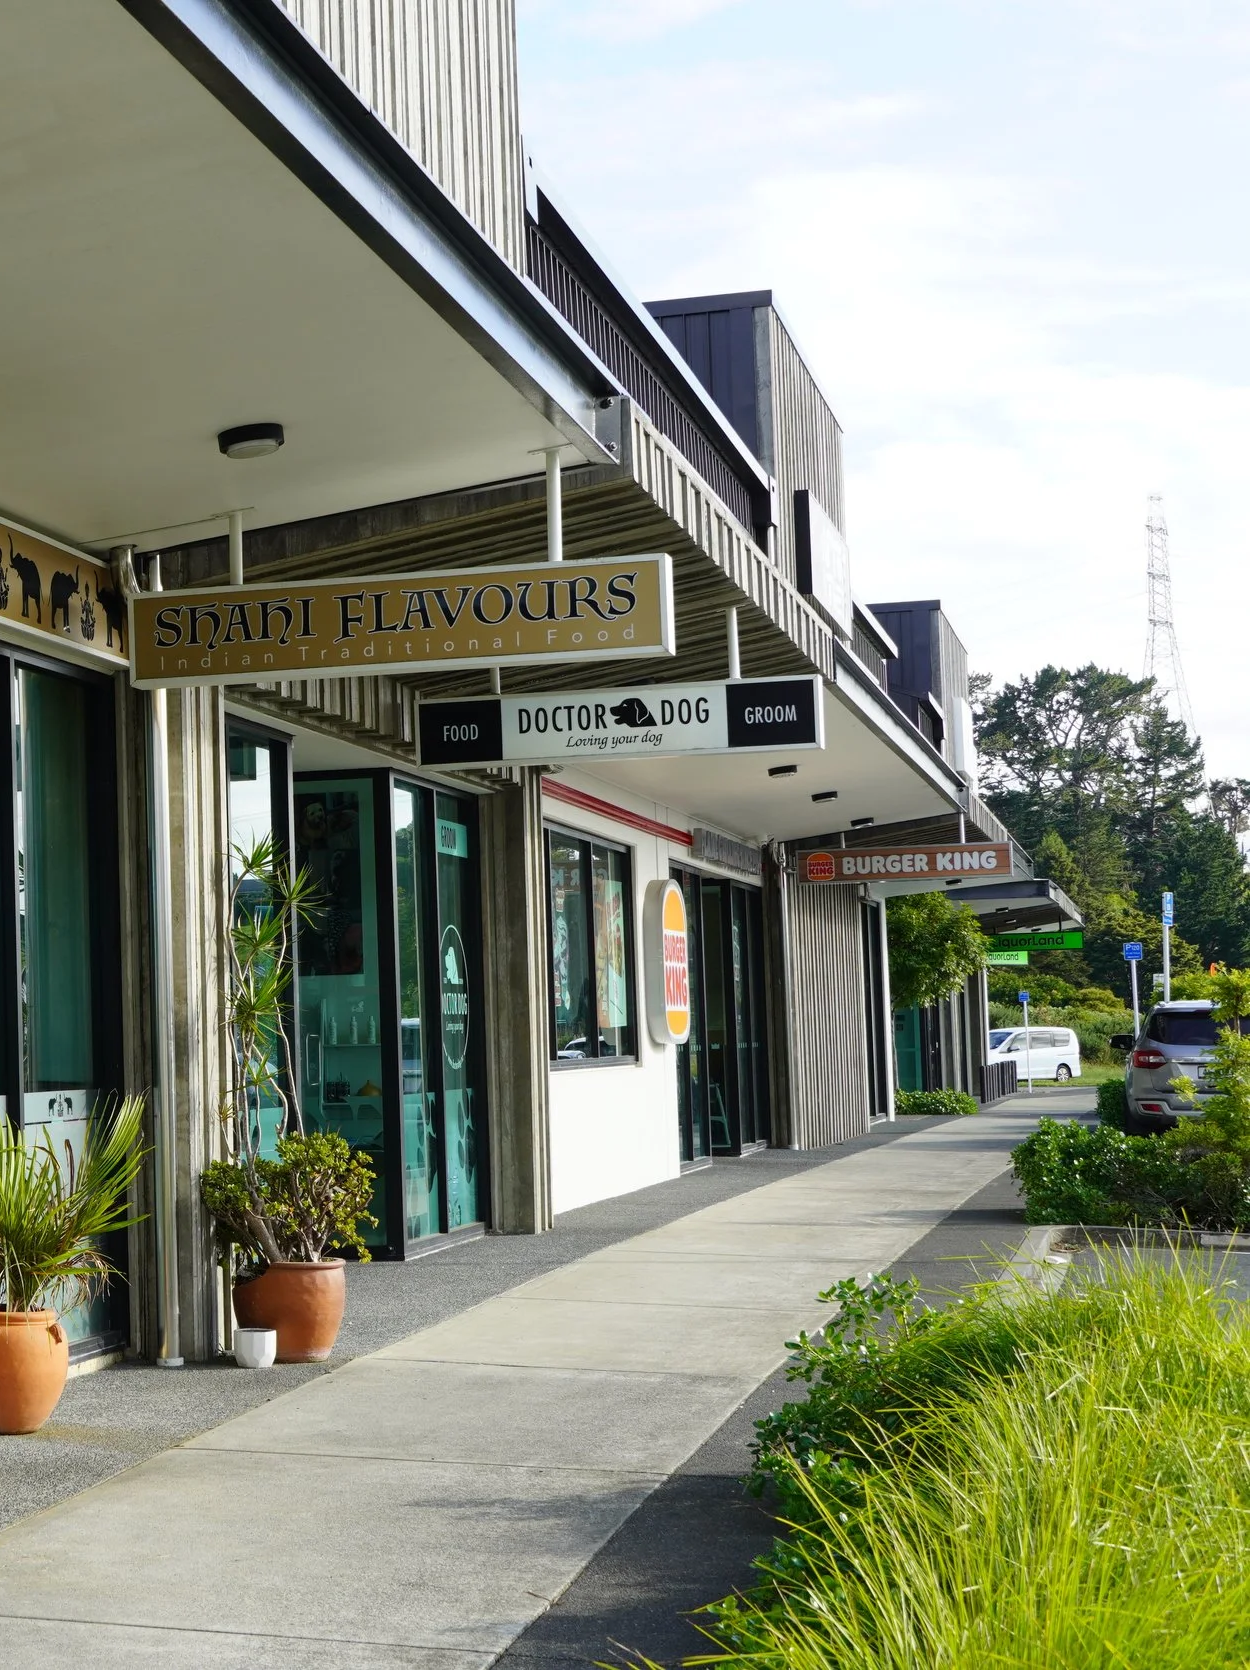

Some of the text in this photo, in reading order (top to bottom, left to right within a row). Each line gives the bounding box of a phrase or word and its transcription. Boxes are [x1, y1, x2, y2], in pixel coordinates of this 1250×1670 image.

[153, 571, 638, 650] SHAHI FLAVOURS
[160, 623, 635, 670] Indian Traditional Food
[518, 697, 710, 734] DOCTOR DOG
[744, 704, 797, 724] GROOM
[443, 724, 479, 742] FOOD
[565, 730, 663, 750] Loving your dog
[808, 867, 834, 875] KING
[842, 850, 997, 875] BURGER KING
[664, 933, 686, 964] BURGER
[665, 965, 688, 1007] KING
